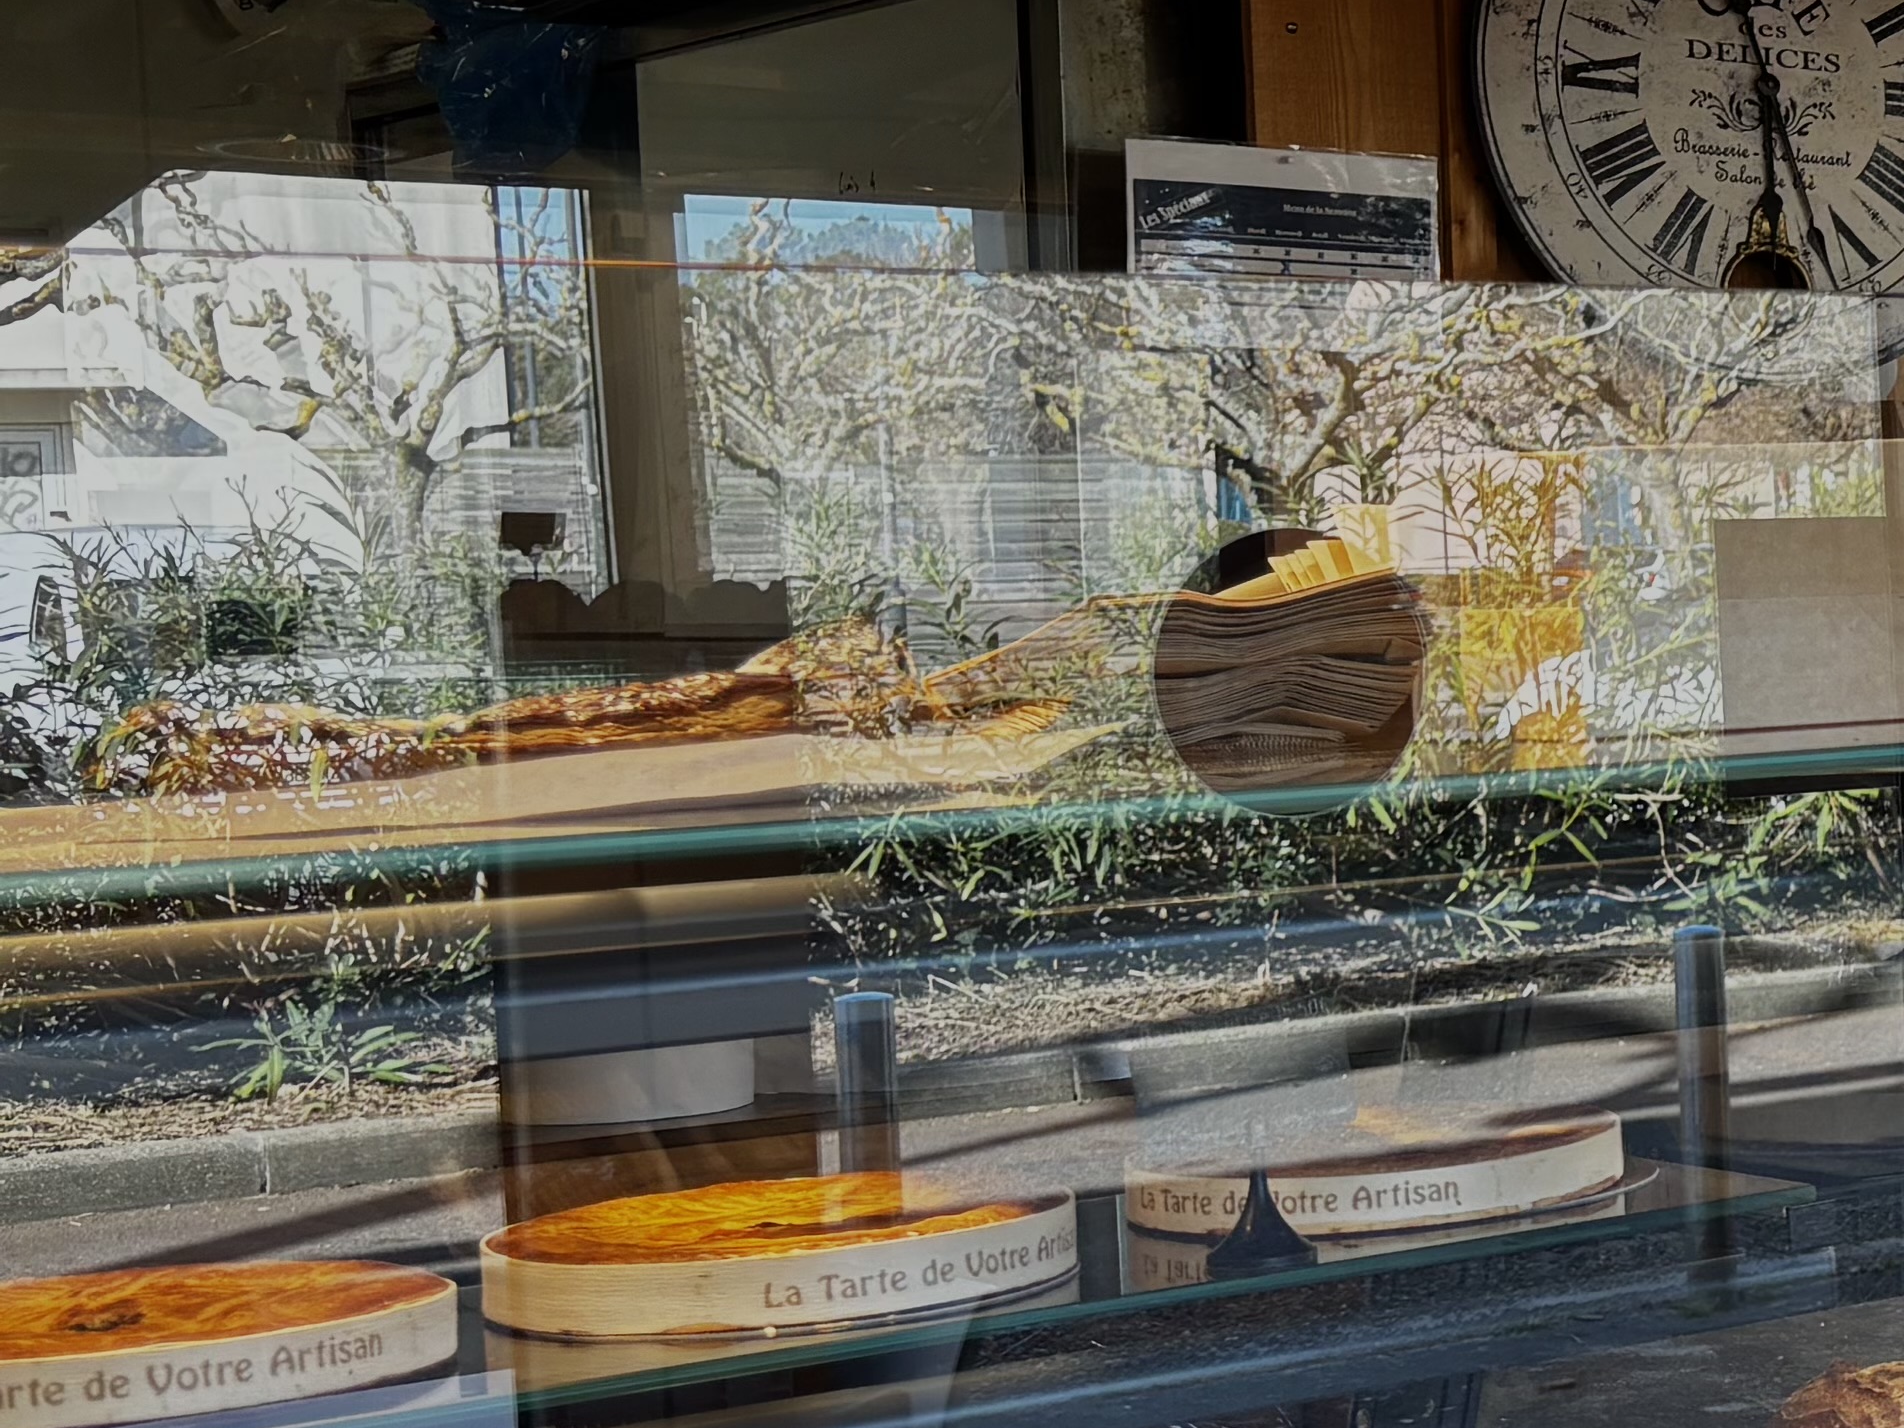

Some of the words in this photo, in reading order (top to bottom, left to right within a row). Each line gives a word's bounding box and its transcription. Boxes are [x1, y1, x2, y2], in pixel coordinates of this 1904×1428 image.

[1685, 39, 1840, 73] DELICES
[1673, 128, 1750, 159] Brasserie
[1715, 160, 1762, 186] Salon
[1161, 1188, 1212, 1215] Tarte
[764, 1282, 801, 1309] La
[818, 1269, 908, 1302] Tarte
[921, 1259, 955, 1287] de
[965, 1244, 1030, 1278] Votre
[83, 1370, 130, 1403] de
[146, 1358, 252, 1396] Votre
[270, 1331, 383, 1375] Artisan
